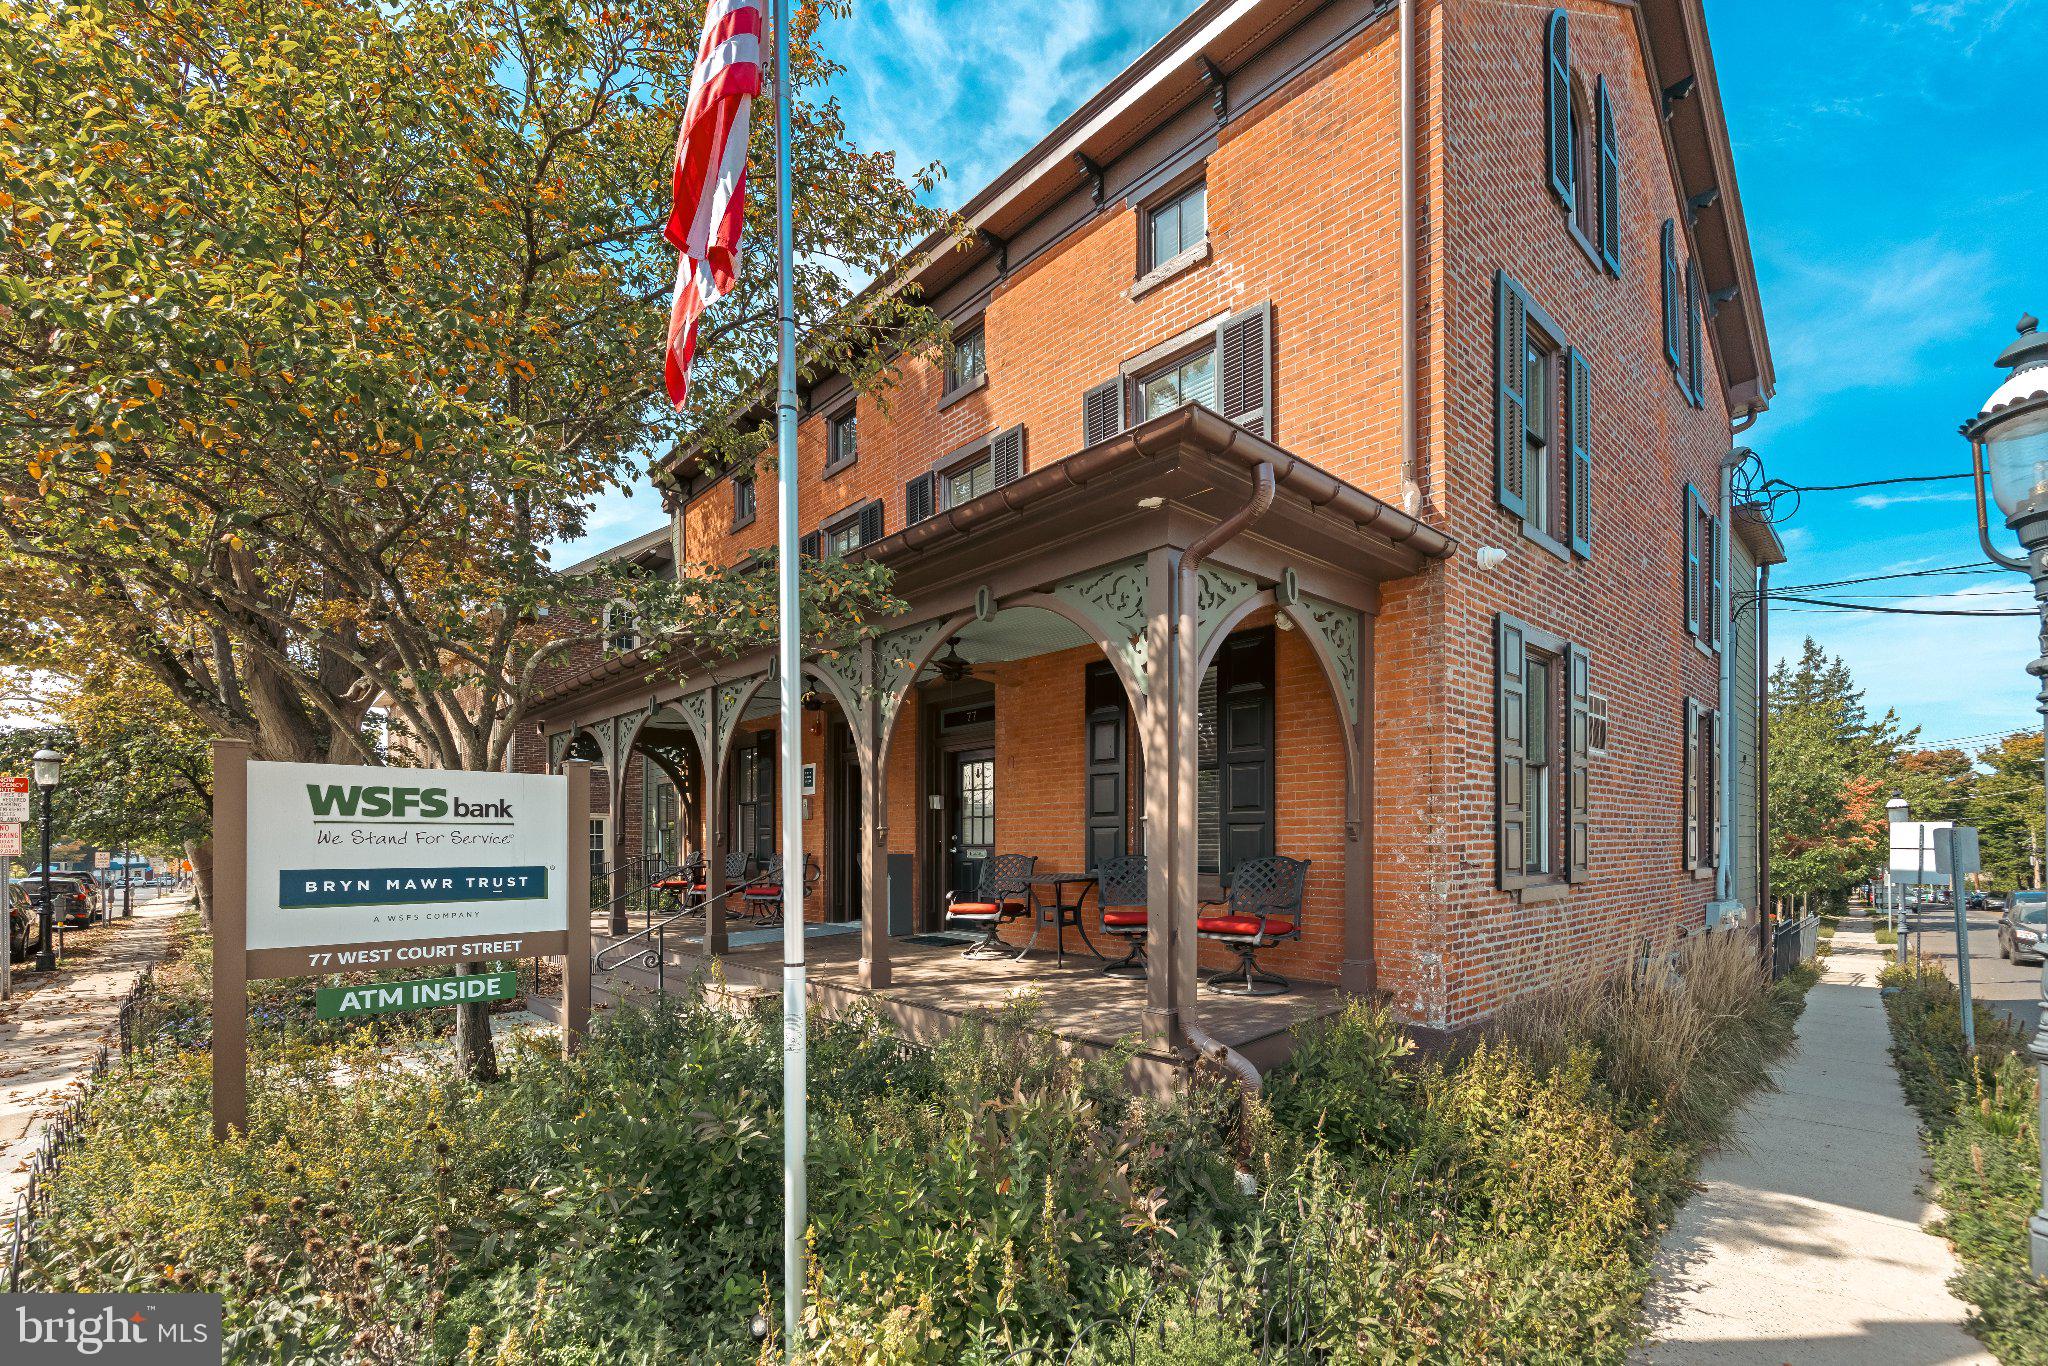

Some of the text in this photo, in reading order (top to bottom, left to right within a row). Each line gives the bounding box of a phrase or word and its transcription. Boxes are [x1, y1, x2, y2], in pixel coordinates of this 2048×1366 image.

[306, 784, 513, 818] WSFS bank
[317, 830, 343, 845] We
[351, 829, 408, 845] Stand
[416, 831, 444, 844] For
[305, 876, 528, 893] BRYN MAWR TRUST
[387, 914, 419, 922] WSFS
[426, 911, 480, 920] COMPANY
[308, 940, 522, 967] 77 WEST COURT STREET
[339, 978, 501, 1012] ATM INSIDE
